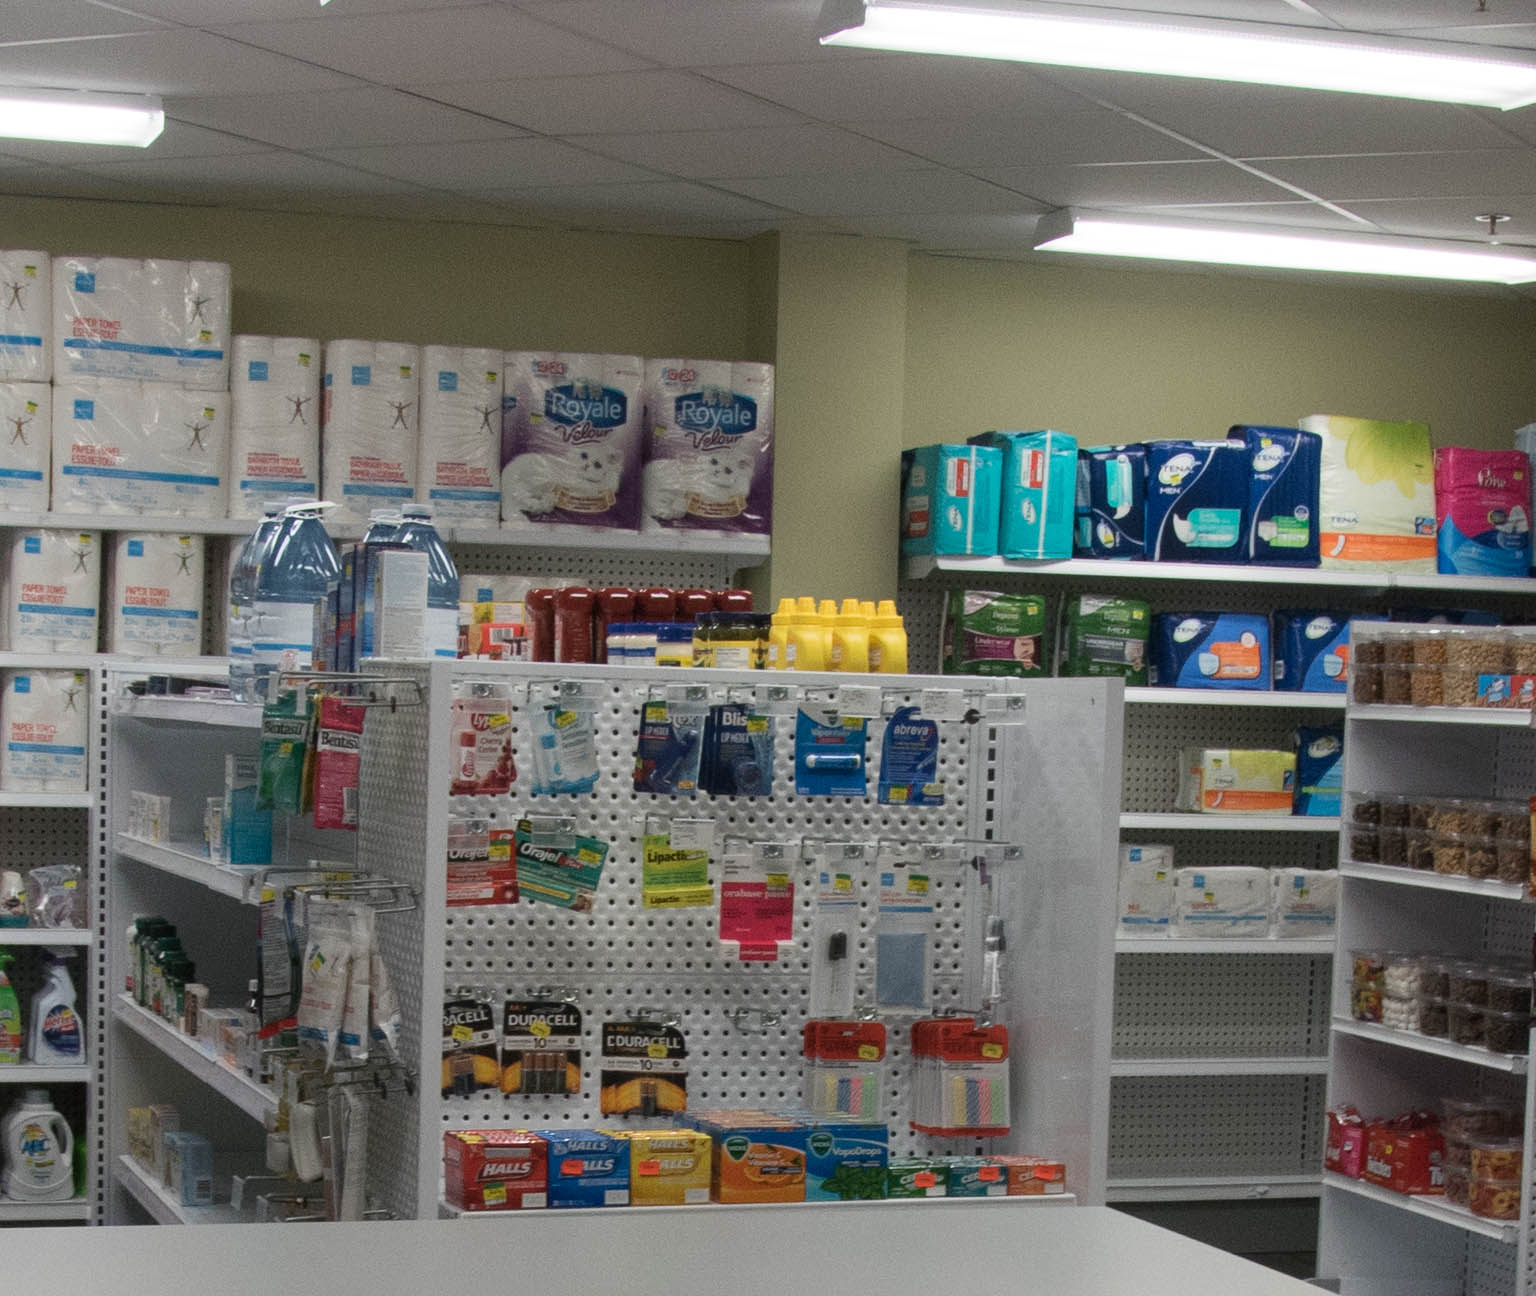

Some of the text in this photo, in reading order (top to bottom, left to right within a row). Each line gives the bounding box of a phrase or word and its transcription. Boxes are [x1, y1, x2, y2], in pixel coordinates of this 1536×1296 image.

[551, 392, 622, 422] Royale
[679, 399, 752, 429] Royale
[555, 420, 613, 445] Velour
[684, 431, 742, 452] Velour
[1162, 463, 1193, 474] TENA
[1330, 515, 1359, 525] TENA
[893, 724, 929, 736] abreva
[519, 842, 561, 864] Orajel
[443, 1010, 489, 1027] RACELL
[507, 1013, 577, 1027] DURACELL
[615, 1036, 681, 1049] DURACELL
[23, 1138, 51, 1155] ABC
[483, 1162, 531, 1176] HALLS
